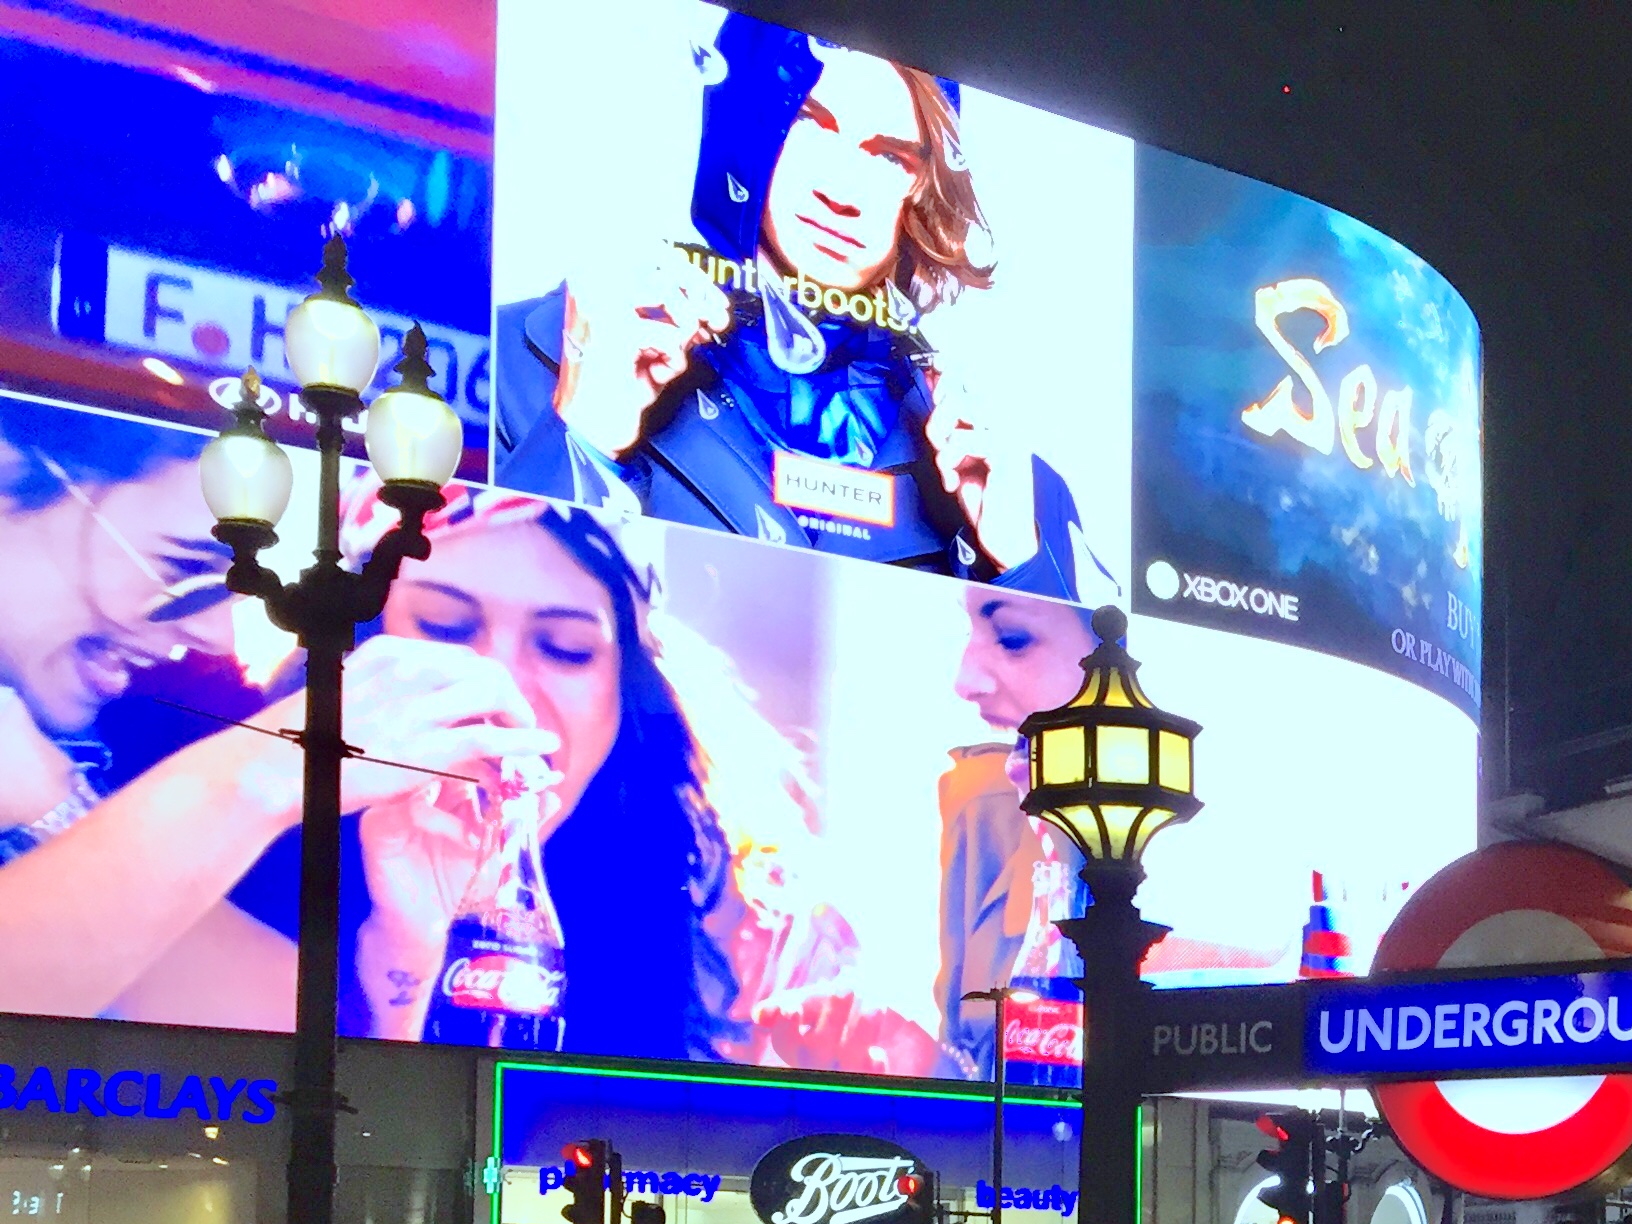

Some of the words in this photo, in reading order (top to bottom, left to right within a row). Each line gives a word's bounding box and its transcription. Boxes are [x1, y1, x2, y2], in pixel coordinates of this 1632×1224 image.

[1241, 278, 1416, 489] Sea
[786, 473, 883, 506] HUNTER
[1182, 572, 1248, 611] XBOX
[1249, 588, 1299, 622] ONE
[1391, 628, 1417, 661] OR
[1420, 639, 1450, 678] PLAY
[1153, 1020, 1272, 1057] PUBLIC
[976, 1179, 1078, 1217] beauty
